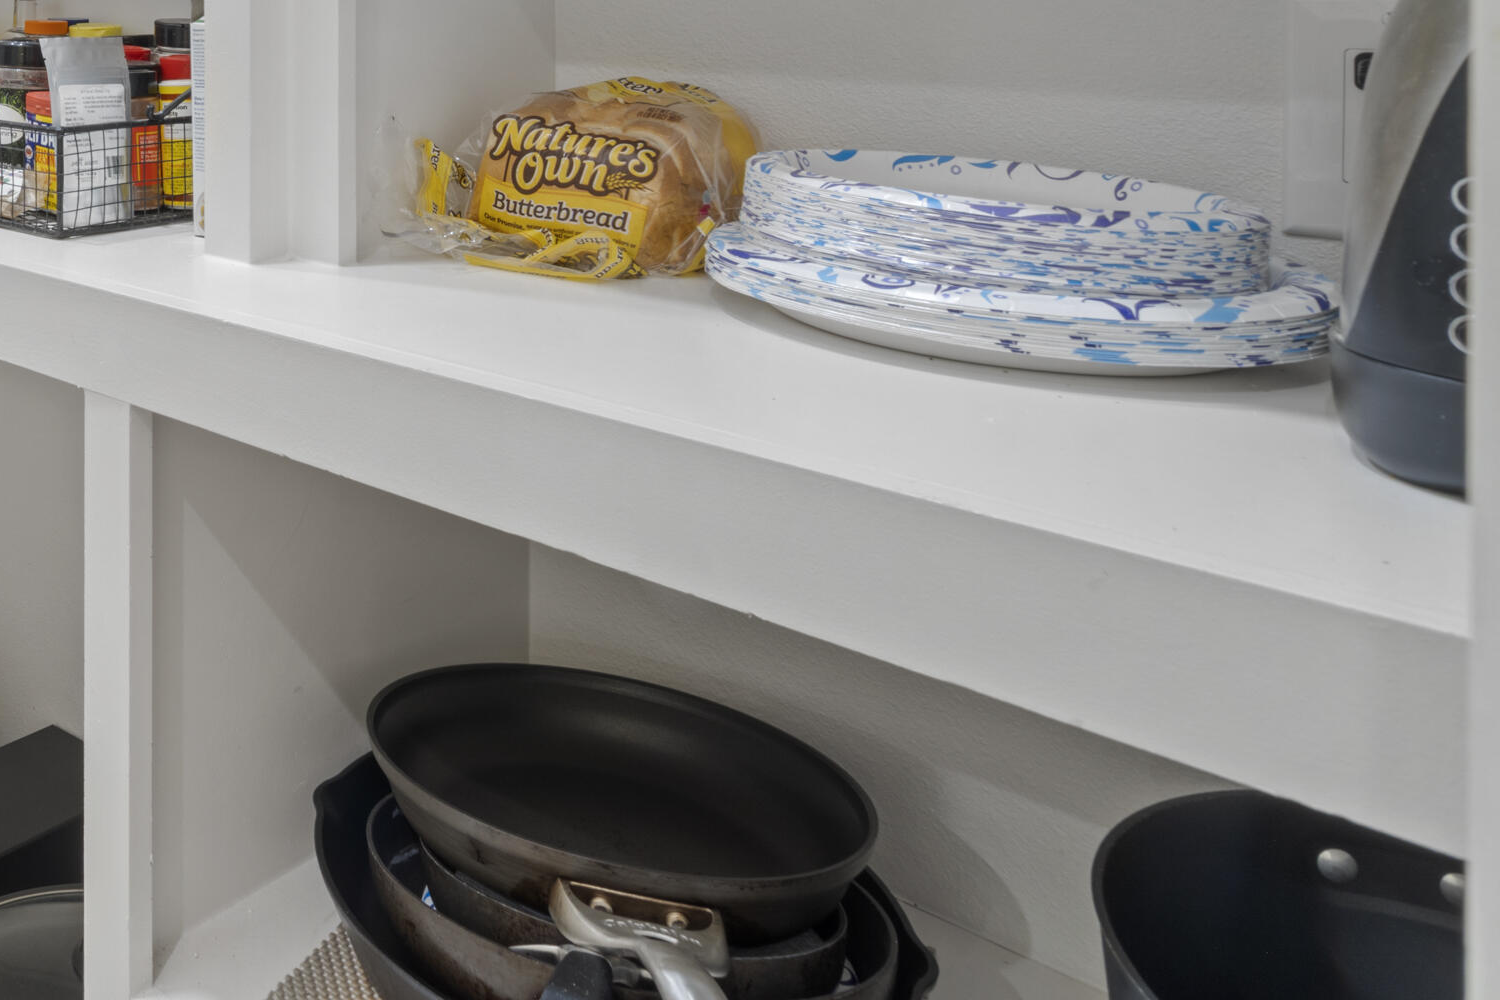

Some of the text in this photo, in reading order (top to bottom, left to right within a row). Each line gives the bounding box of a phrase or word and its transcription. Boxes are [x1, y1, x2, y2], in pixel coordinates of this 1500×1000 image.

[492, 117, 658, 177] Nature's
[514, 150, 608, 193] Own
[493, 190, 629, 233] Butterbread
